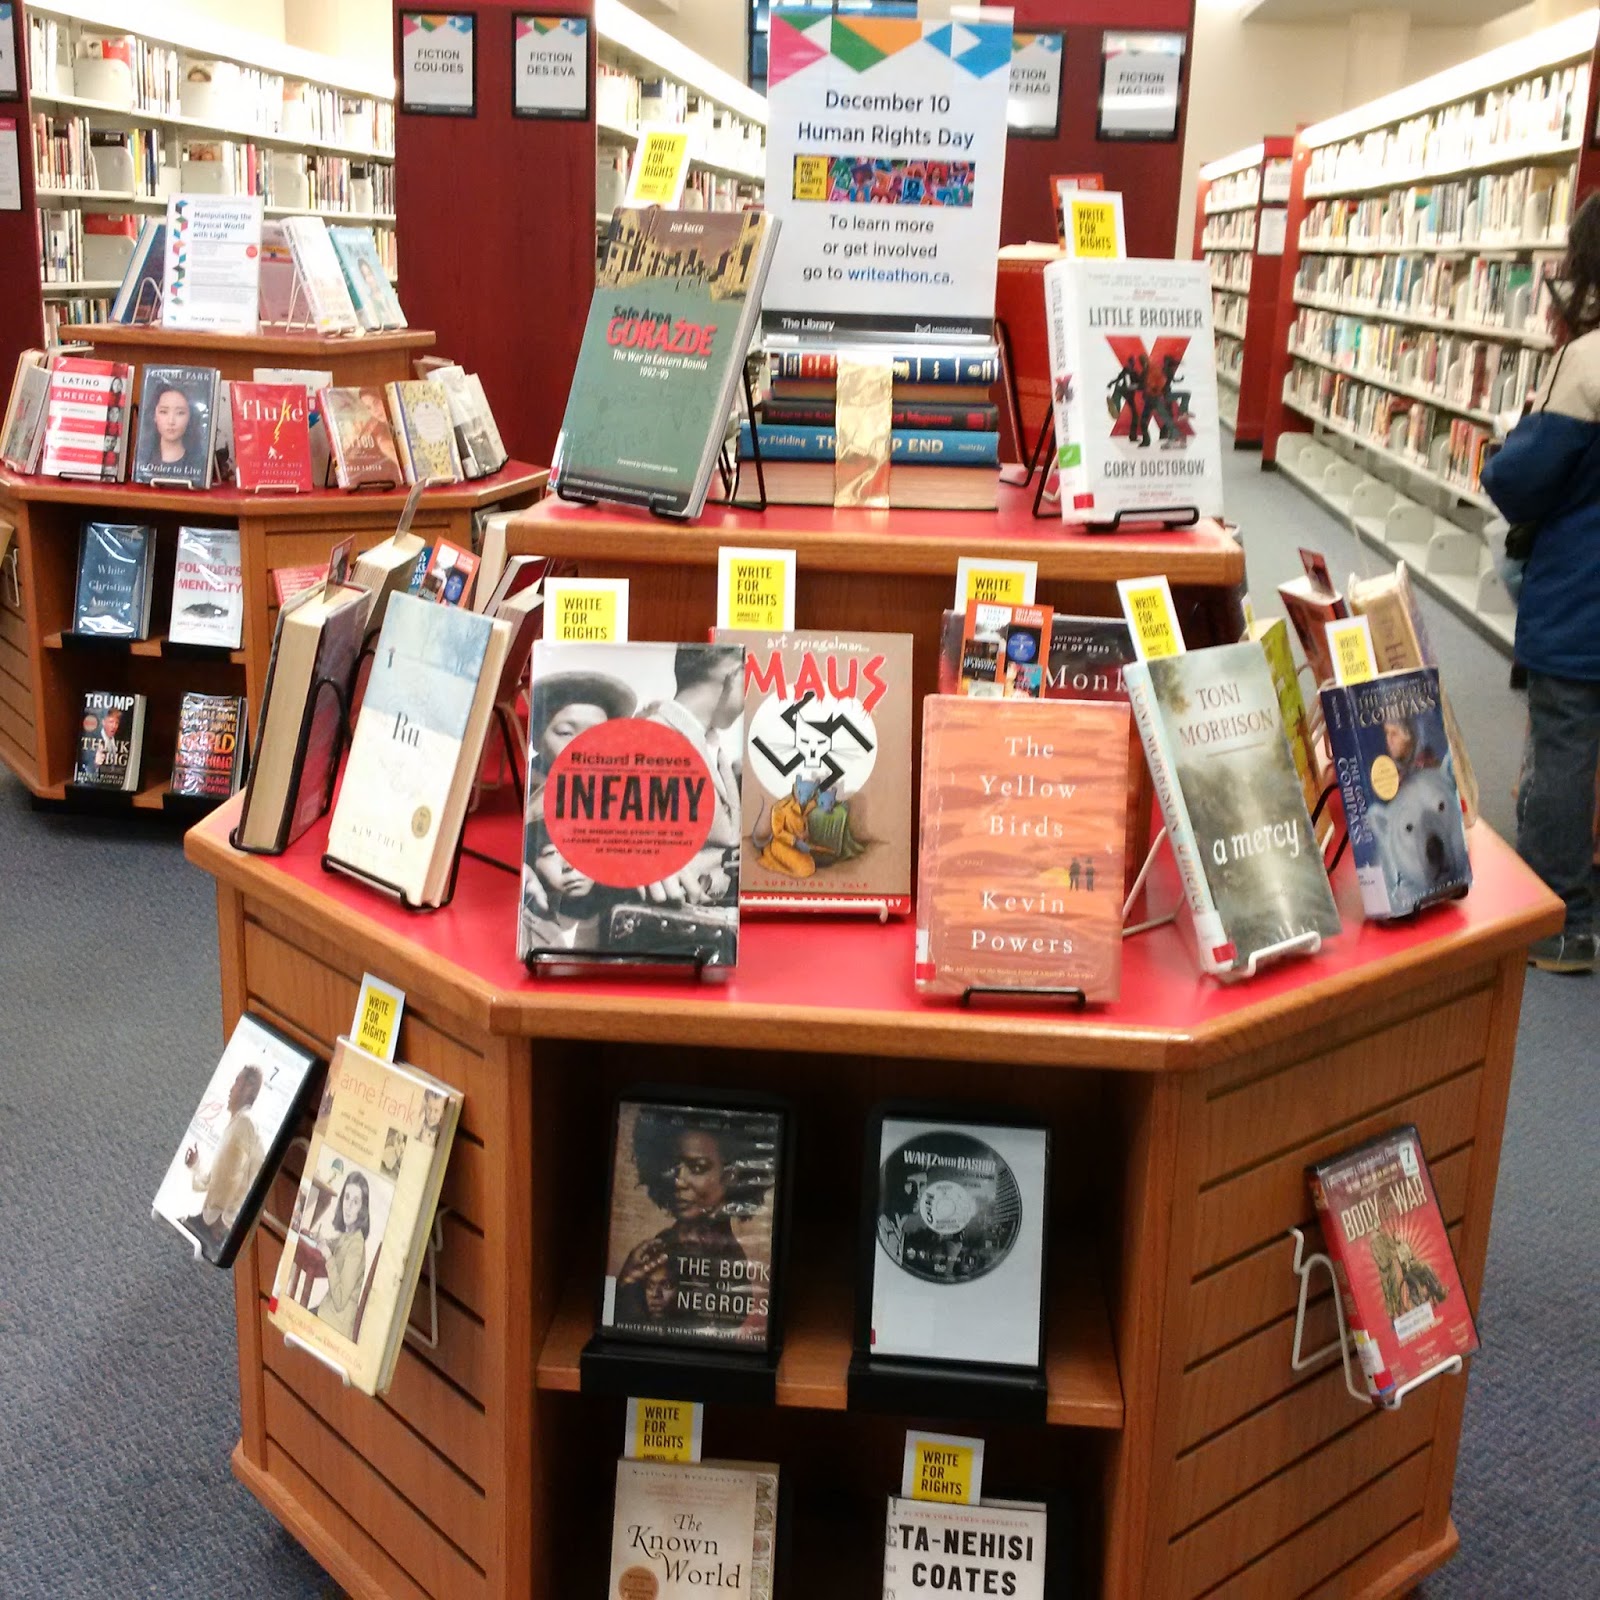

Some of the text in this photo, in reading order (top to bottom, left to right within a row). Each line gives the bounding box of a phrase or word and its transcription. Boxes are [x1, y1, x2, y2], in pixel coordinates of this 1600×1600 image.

[418, 49, 460, 60] FICTION
[530, 52, 572, 63] FICTION
[414, 62, 464, 73] COU-DES
[527, 64, 576, 76] DES-EVA
[1119, 72, 1165, 82] FICTION
[826, 90, 951, 115] December 10
[798, 122, 975, 150] Human Rights Day
[651, 139, 676, 152] WRITE
[648, 152, 664, 164] FOR
[644, 166, 674, 178] RIGHTS
[194, 212, 239, 221] Manipulating
[830, 215, 934, 233] To learn more
[1078, 208, 1105, 224] WRITE
[194, 222, 222, 231] Physical
[670, 222, 704, 234] Joe Sacco
[1080, 223, 1096, 234] FOR
[210, 232, 228, 240] Light
[1080, 236, 1112, 250] RIGHTS
[823, 241, 938, 258] or get involved
[803, 266, 954, 284] go to writeathon.ca.
[614, 305, 672, 325] Safe Area
[1089, 307, 1204, 328] LITTLE BROTHER
[782, 317, 836, 333] The Library
[606, 316, 718, 356] GORAŽDE
[612, 350, 708, 370] The War in Eastern Bosnia
[62, 376, 100, 387] LATINO
[56, 392, 103, 402] AMERICA
[242, 398, 304, 422] fluke
[770, 436, 806, 448] Fielding
[908, 438, 944, 452] END
[147, 462, 170, 474] Order
[173, 464, 182, 473] to
[184, 464, 202, 475] Live
[1104, 460, 1206, 478] CORY DOCTOROW
[98, 564, 126, 575] White
[738, 566, 772, 579] WRITE
[88, 580, 132, 592] Christian
[738, 580, 759, 592] FOR
[976, 577, 1012, 592] WRITE
[564, 597, 602, 610] WRITE
[737, 594, 777, 606] RIGHTS
[974, 592, 997, 600] FOR
[1135, 595, 1159, 610] WRITE
[564, 612, 588, 625] FOR
[1138, 610, 1154, 623] FOR
[564, 627, 608, 640] RIGHTS
[1142, 623, 1169, 638] RIGHTS
[766, 634, 788, 650] art
[1340, 635, 1360, 648] WRITE
[1342, 651, 1354, 661] FOR
[1345, 660, 1368, 676] RIGHTS
[744, 650, 888, 714] MAUS
[85, 693, 134, 711] TRUMP
[1196, 682, 1240, 710] TONI
[1360, 696, 1436, 728] COMPASS
[393, 711, 420, 747] Ru
[1179, 708, 1275, 746] MORRISON
[1005, 736, 1054, 758] The
[104, 754, 128, 766] BIG
[571, 752, 691, 766] Richard Reeves
[980, 774, 1076, 798] Yellow
[555, 774, 707, 822] INFAMY
[1337, 756, 1362, 844] COMPASS
[990, 815, 1064, 838] Birds
[1213, 819, 1300, 866] a mercy
[982, 890, 1064, 914] Kevin
[971, 930, 1073, 954] Powers
[368, 994, 390, 1015] WRITE
[365, 1010, 380, 1026] FOR
[362, 1020, 388, 1044] RIGHTS
[268, 1066, 280, 1081] 7
[340, 1073, 376, 1104] anne
[378, 1075, 416, 1126] frank
[904, 1150, 940, 1170] WALTZ
[1403, 1148, 1410, 1163] 7
[1341, 1176, 1427, 1242] BODY WAR
[677, 1256, 770, 1282] THE BOOK
[678, 1292, 770, 1316] NEGROES
[644, 1406, 680, 1420] WRITE
[644, 1420, 666, 1434] FOR
[644, 1434, 684, 1449] RIGHTS
[923, 1451, 959, 1467] WRITE
[922, 1465, 944, 1478] FOR
[921, 1479, 962, 1496] RIGHTS
[674, 1514, 703, 1532] The
[628, 1524, 718, 1559] Known
[899, 1524, 1033, 1562] TA-NEHISI
[655, 1552, 742, 1590] World
[912, 1562, 1016, 1596] COATES
